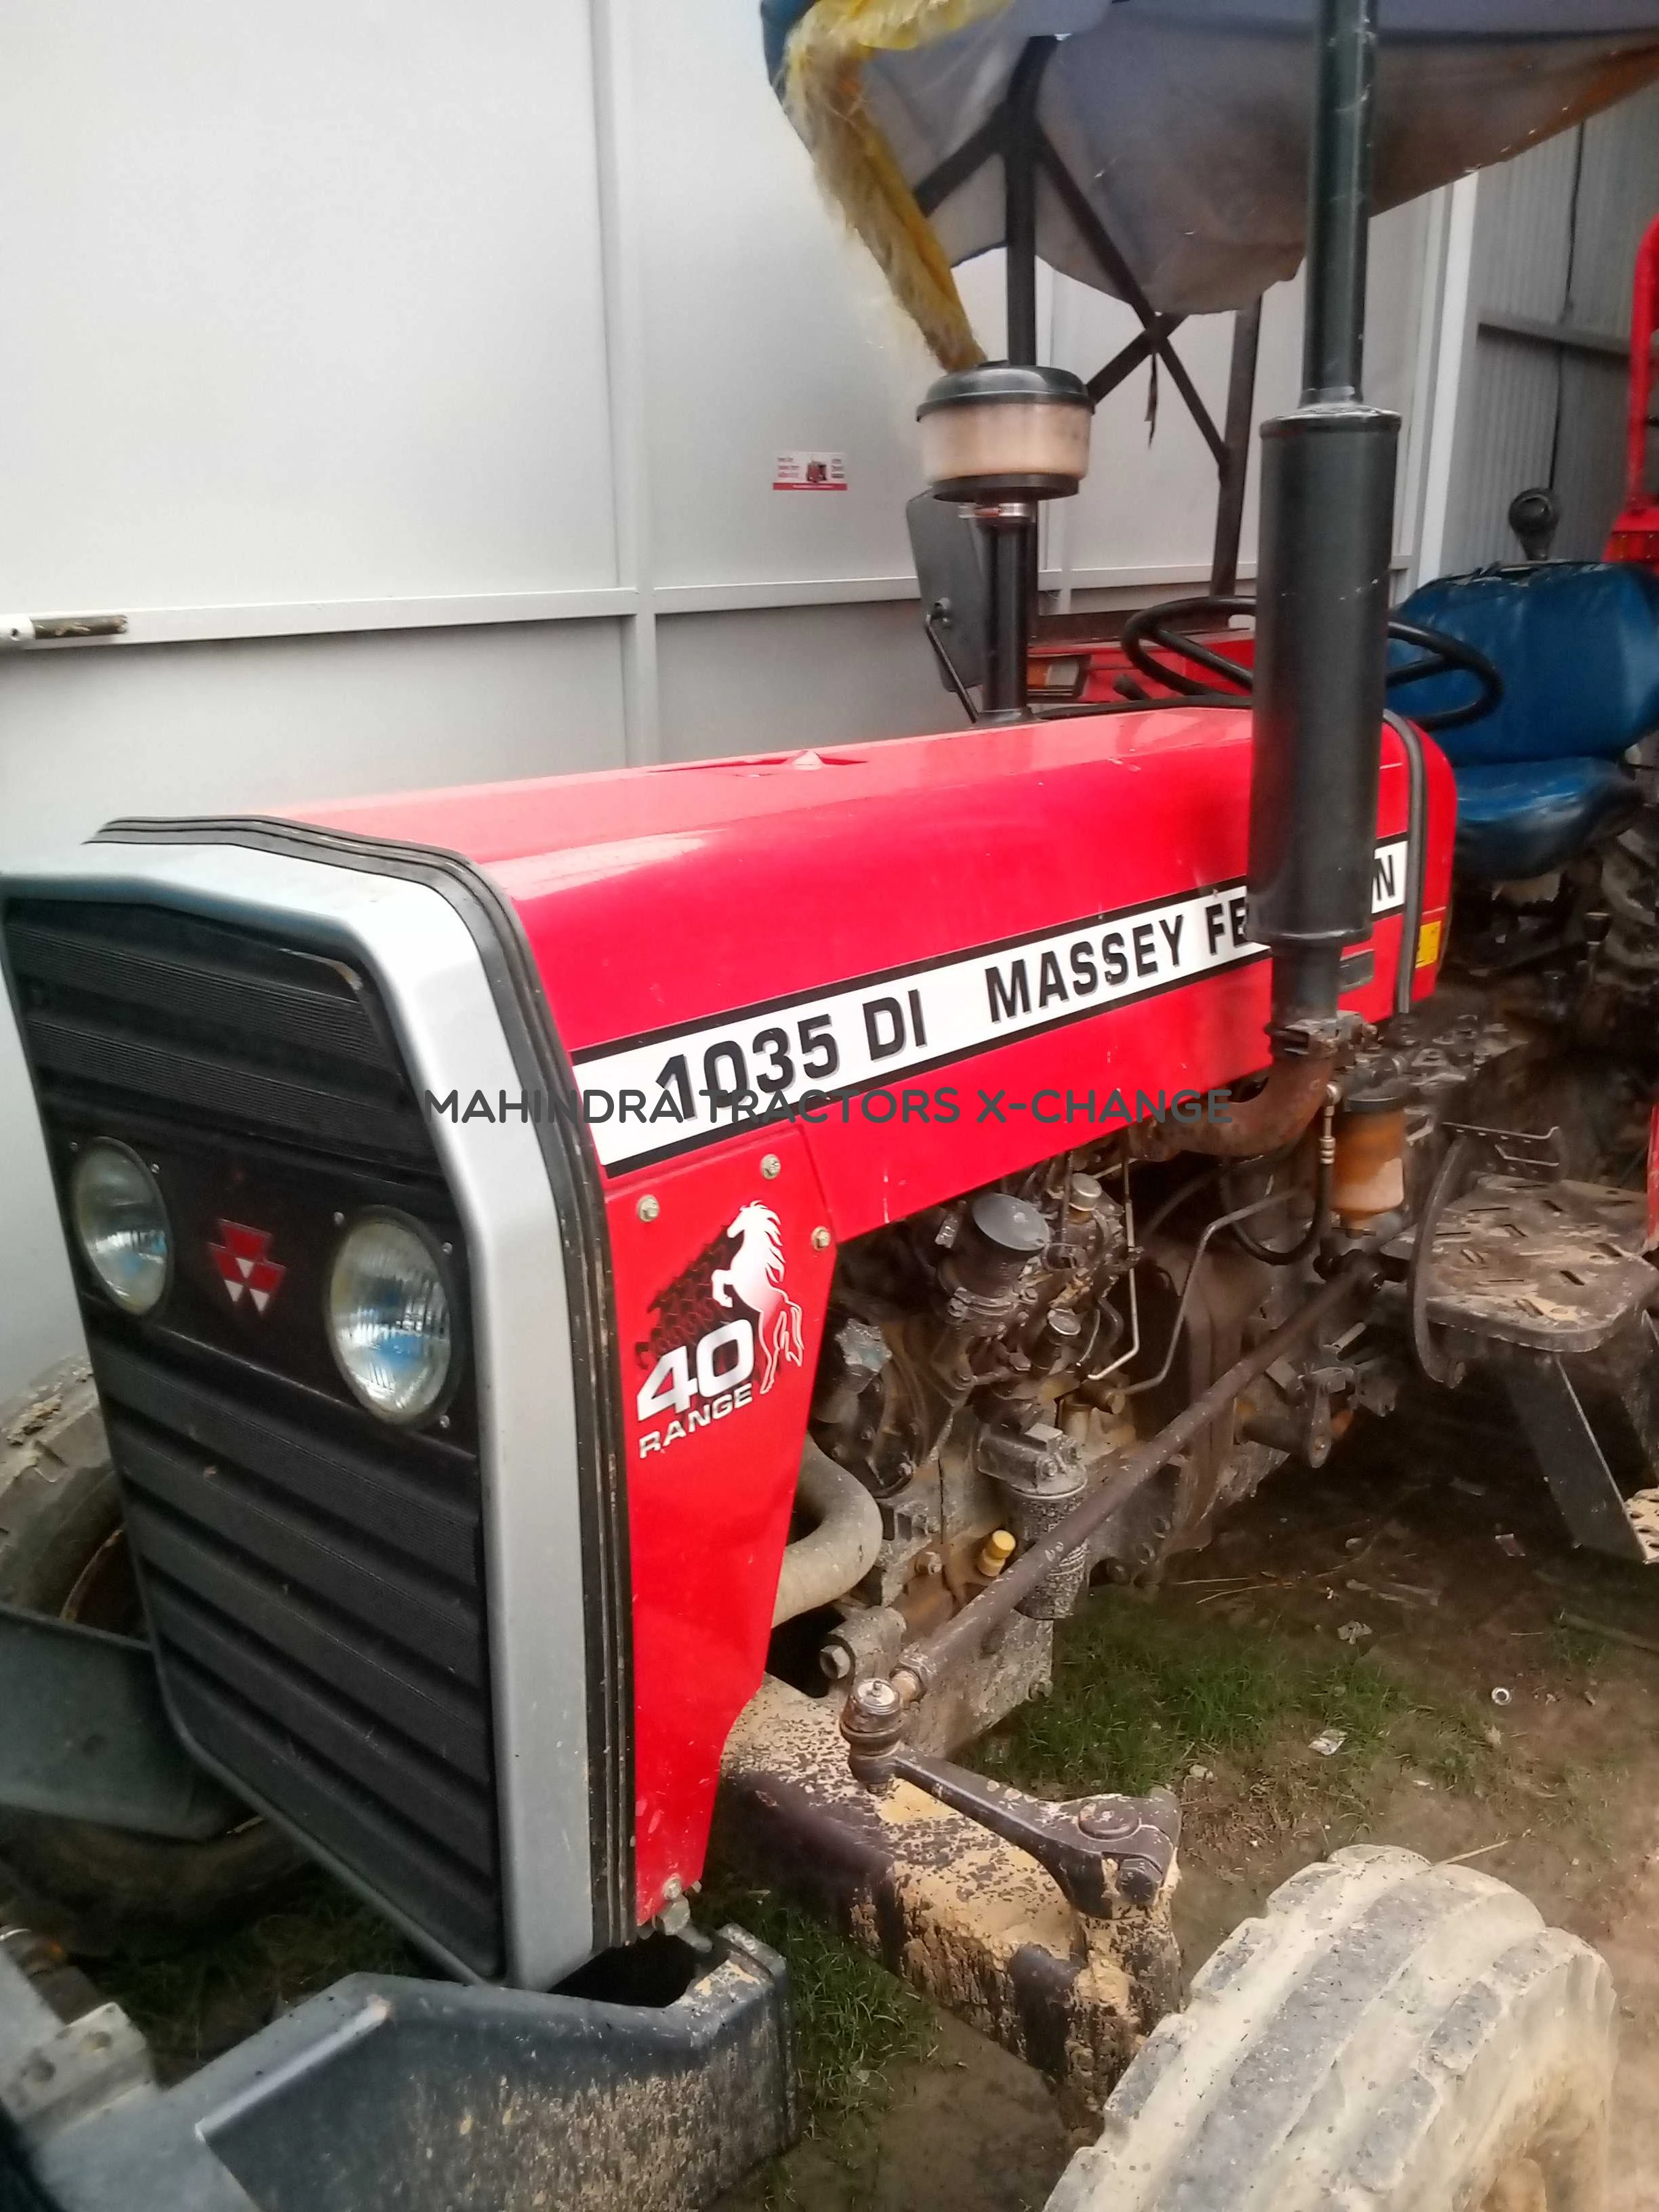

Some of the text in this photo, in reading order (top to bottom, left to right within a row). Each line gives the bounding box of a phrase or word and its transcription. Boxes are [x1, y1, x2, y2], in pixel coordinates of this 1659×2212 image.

[655, 914, 1185, 1121] 1035 DI MASSEY
[636, 1319, 754, 1422] 40
[638, 1382, 754, 1459] RANGE
